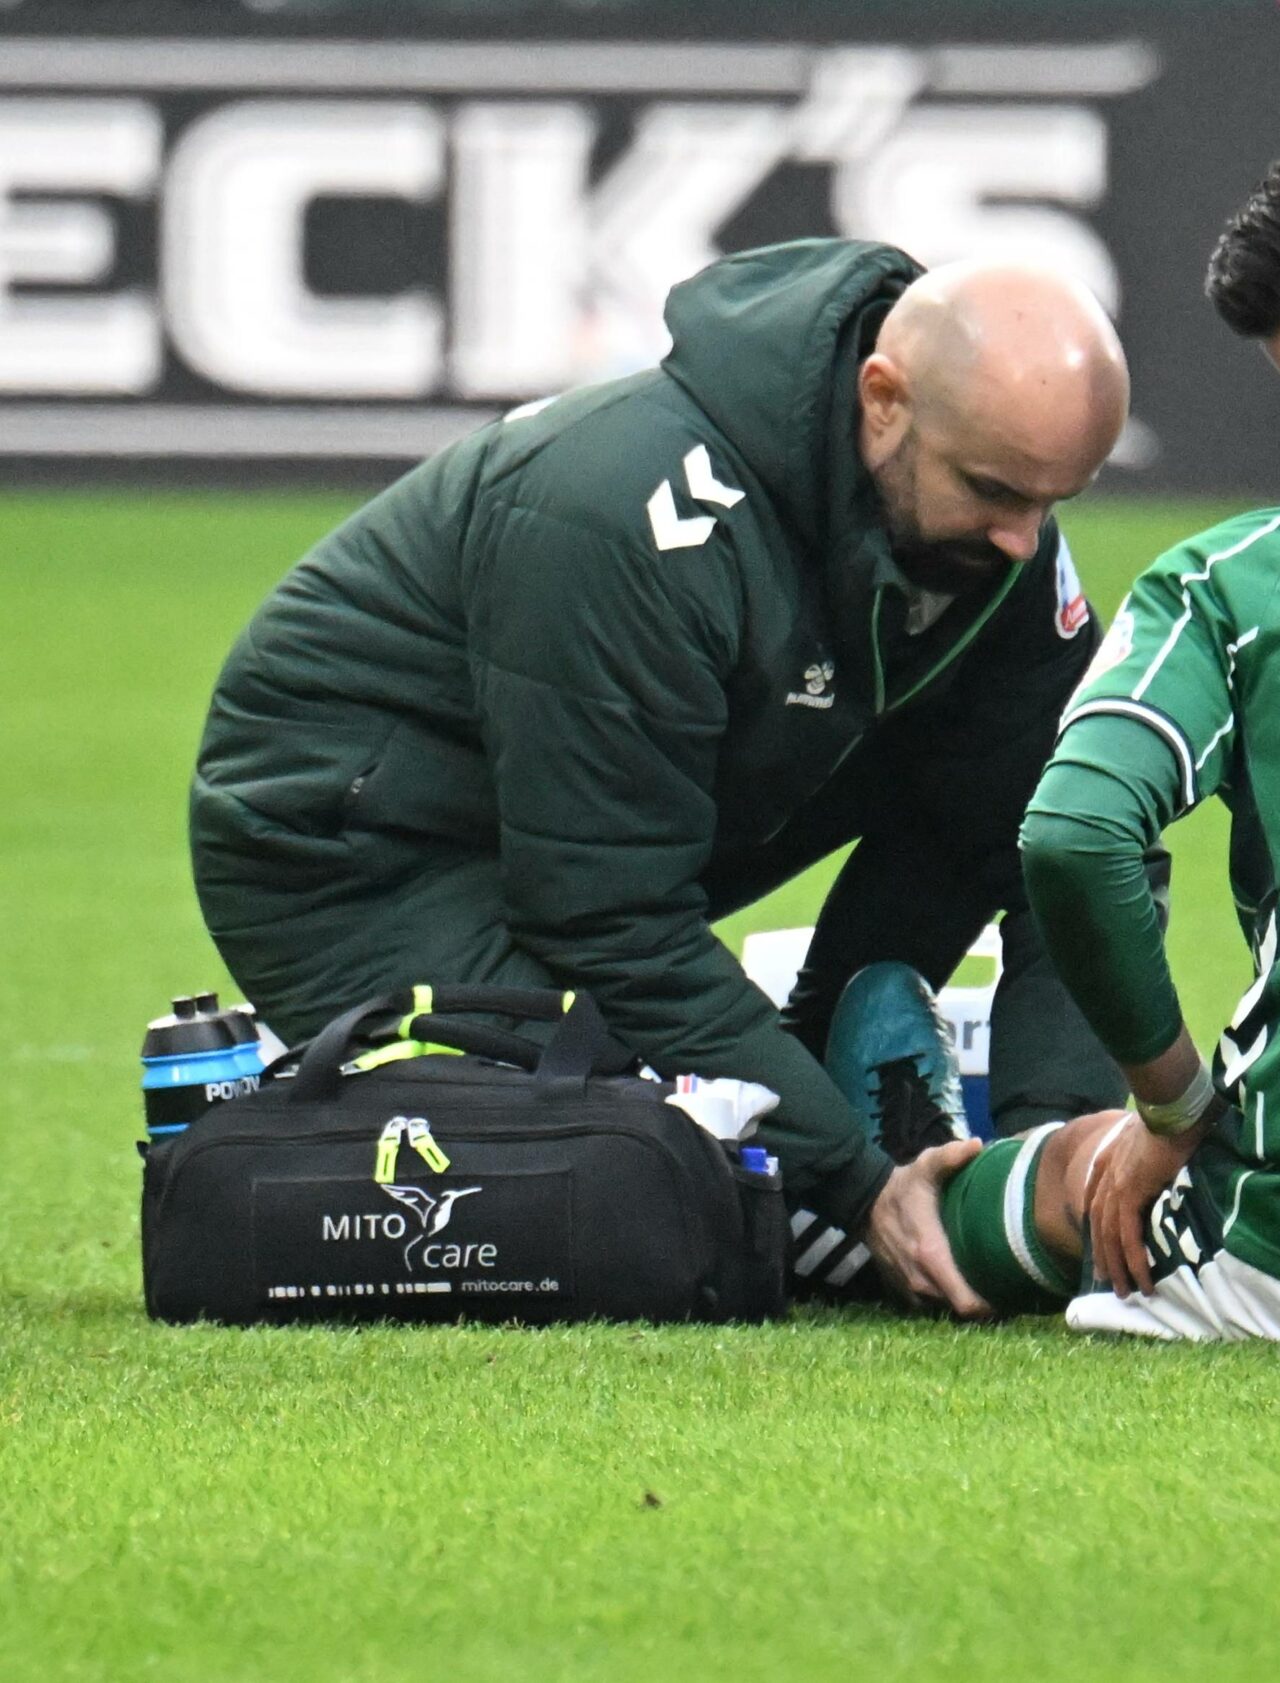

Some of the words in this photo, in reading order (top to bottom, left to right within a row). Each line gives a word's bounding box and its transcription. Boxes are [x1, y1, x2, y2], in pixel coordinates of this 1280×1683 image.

[322, 1214, 406, 1241] MITO
[422, 1243, 498, 1269] care
[461, 1278, 560, 1294] mitocare.de
